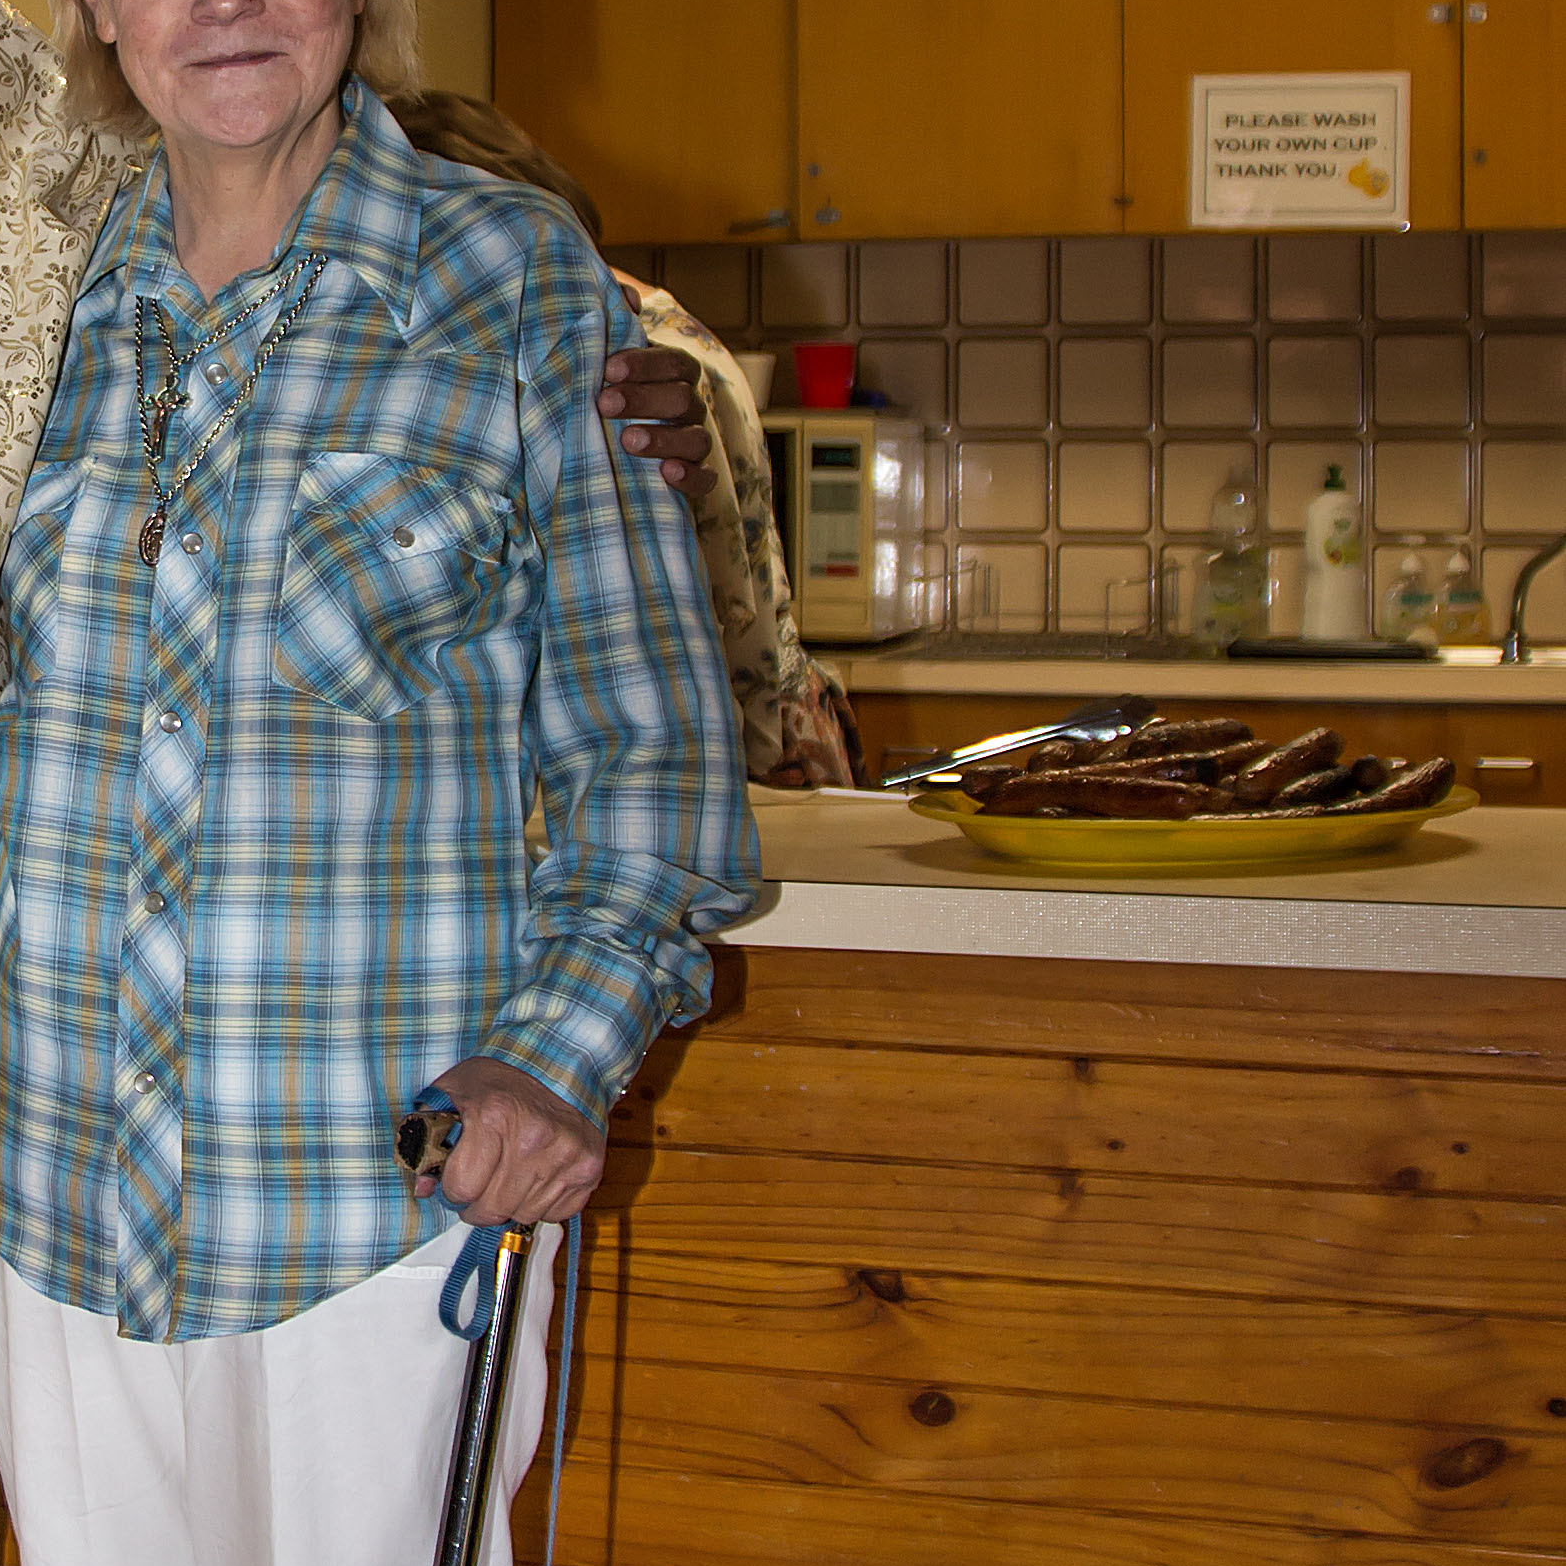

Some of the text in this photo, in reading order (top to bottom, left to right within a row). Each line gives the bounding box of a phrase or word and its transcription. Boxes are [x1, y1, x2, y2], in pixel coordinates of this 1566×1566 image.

[1225, 113, 1377, 128] PLEASE WASH
[1214, 138, 1270, 152] YOUR
[1276, 138, 1327, 151] OWN
[1215, 164, 1287, 178] THANK
